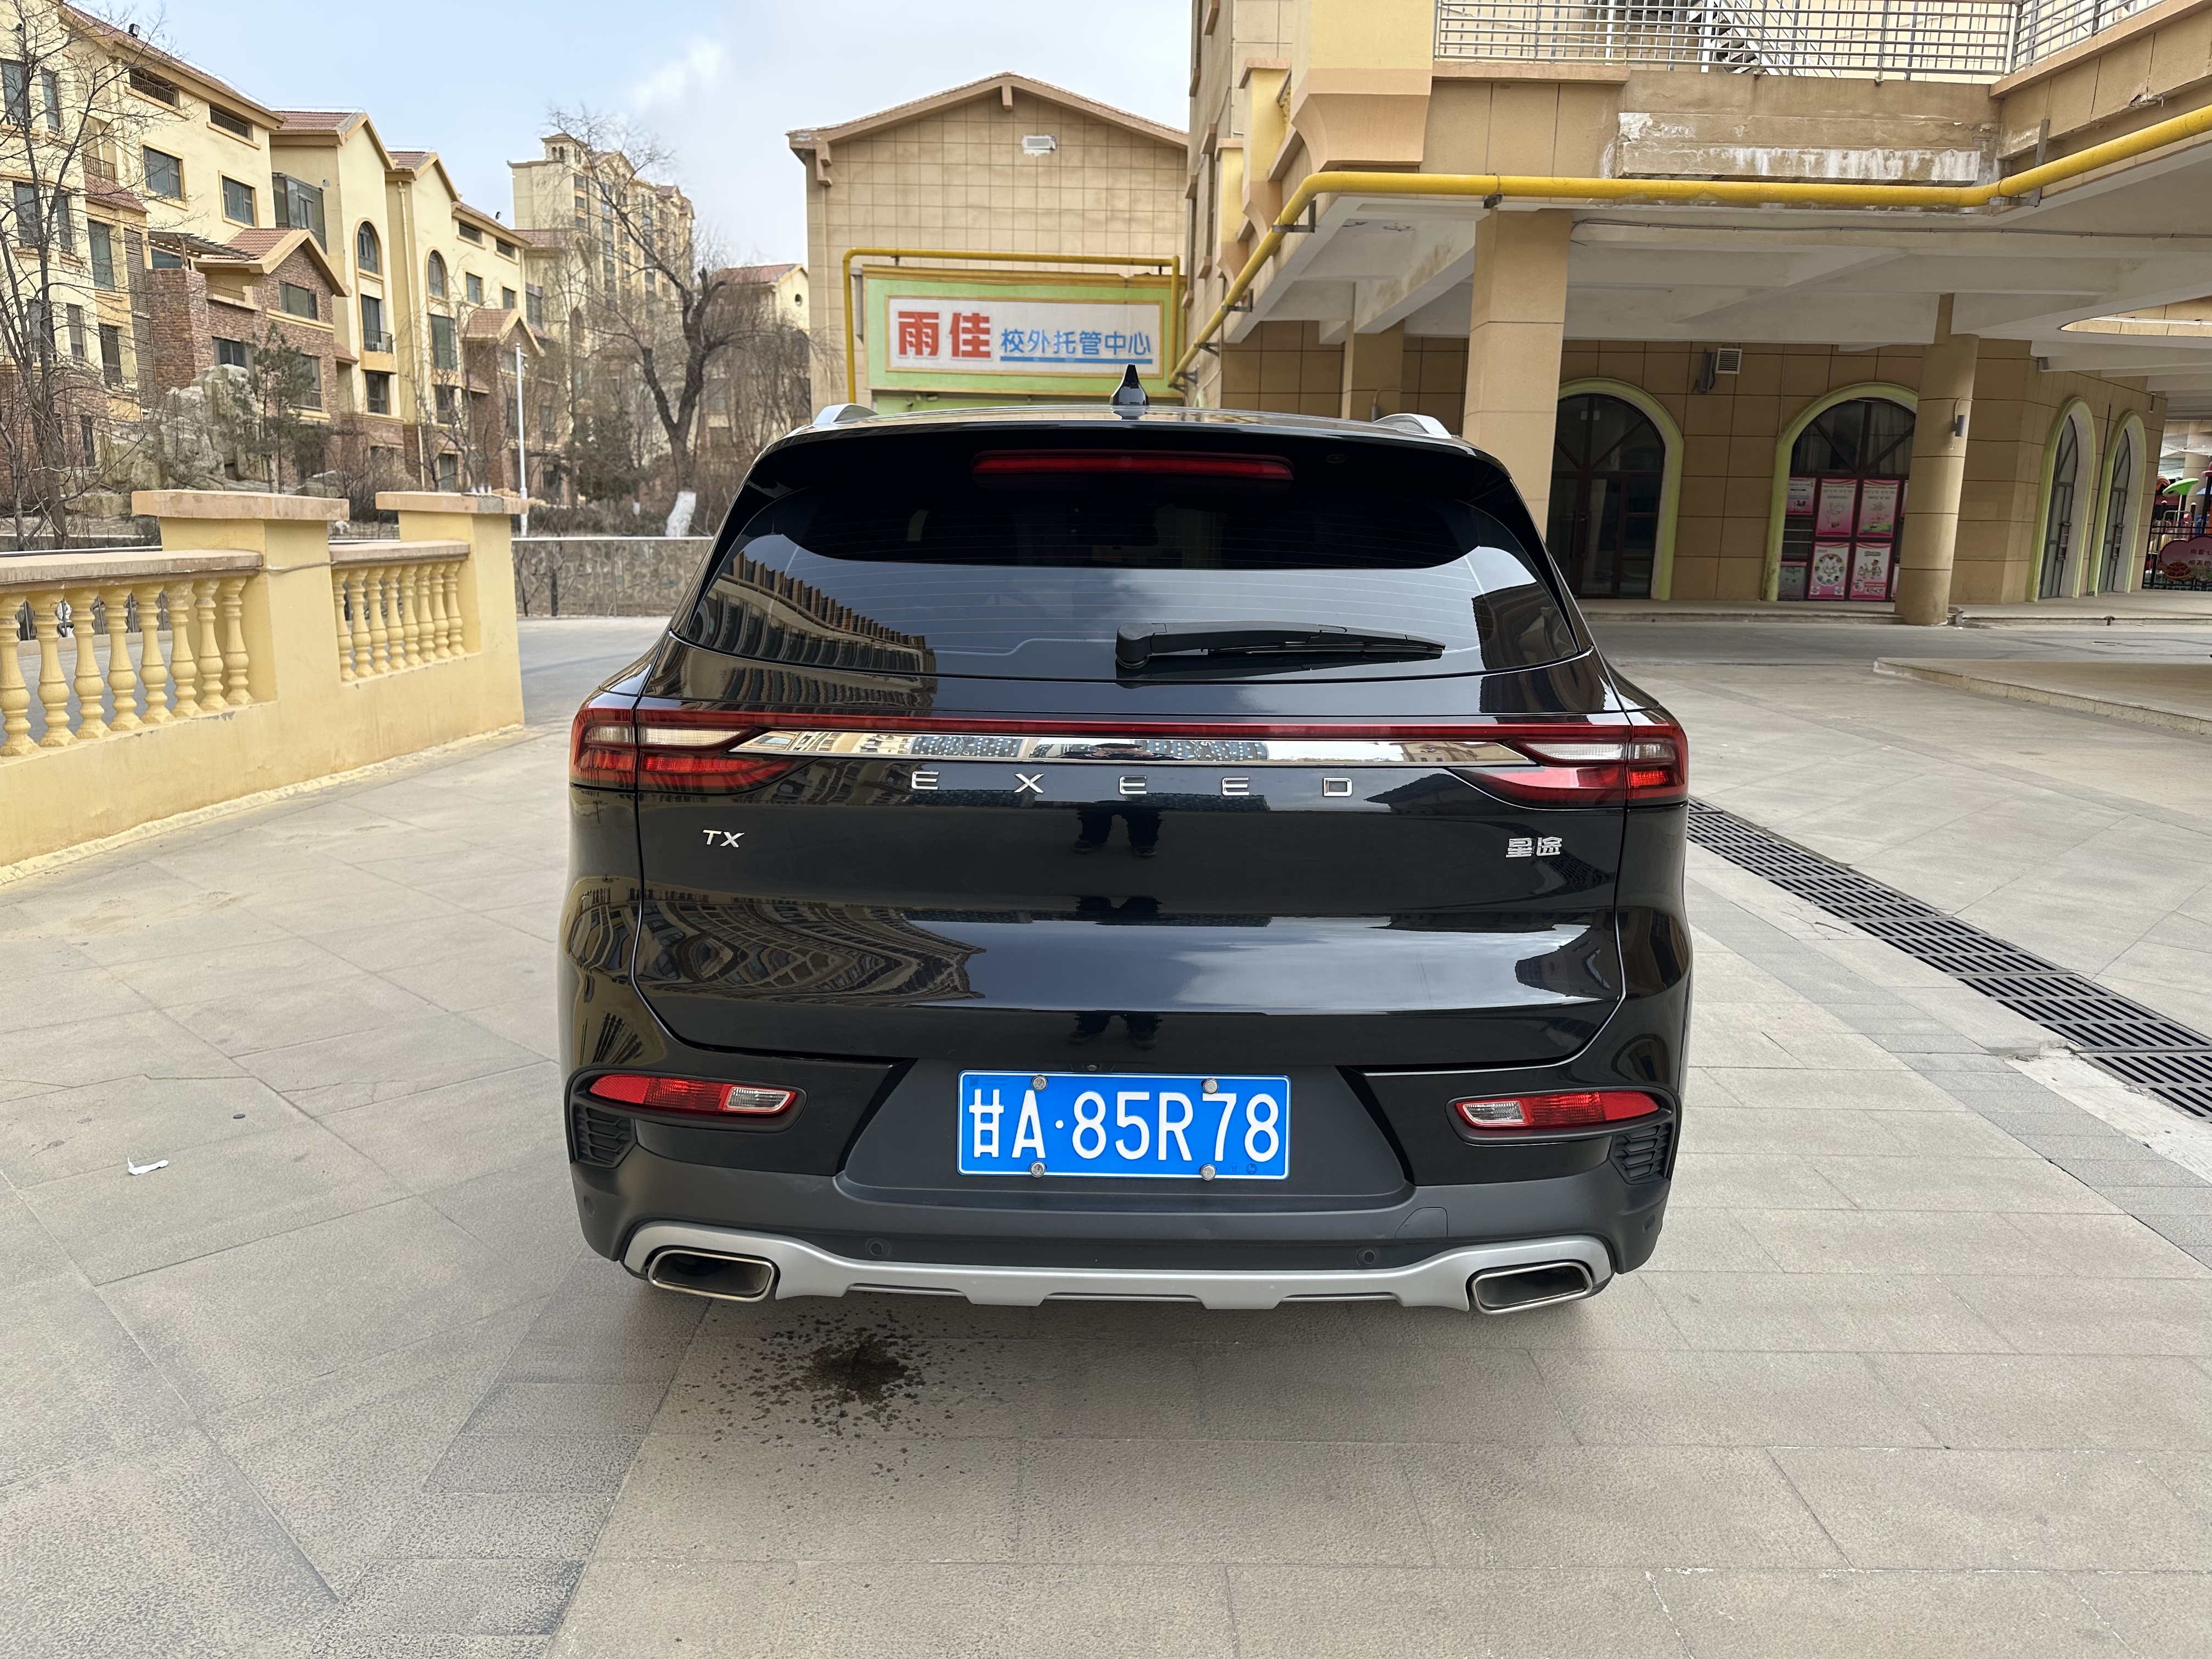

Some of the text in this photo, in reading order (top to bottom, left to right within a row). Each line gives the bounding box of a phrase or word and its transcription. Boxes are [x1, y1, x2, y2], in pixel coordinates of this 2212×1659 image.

[898, 311, 1151, 358] 雨佳 校外托管中心
[911, 771, 1353, 797] EXEED
[703, 830, 745, 848] TX
[1505, 836, 1562, 858] 星途
